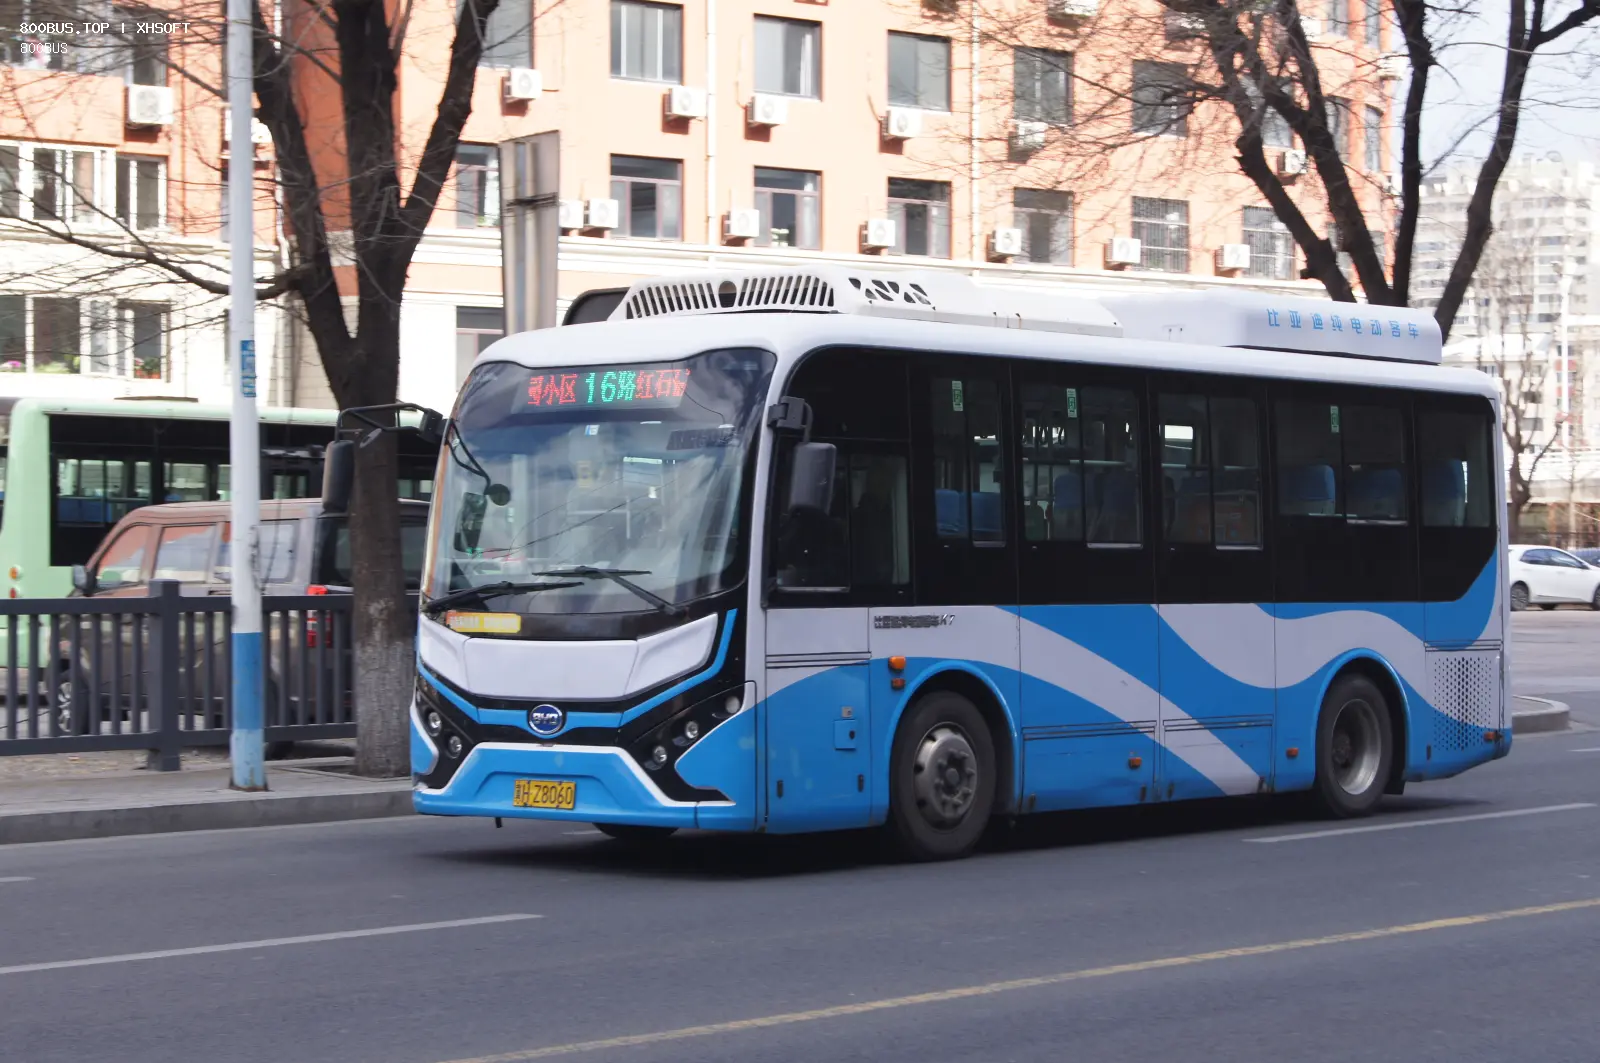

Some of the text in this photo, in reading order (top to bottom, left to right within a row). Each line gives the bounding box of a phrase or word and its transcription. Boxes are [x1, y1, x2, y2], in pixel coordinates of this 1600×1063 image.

[1266, 308, 1419, 340] 比亚迪纯电动客车
